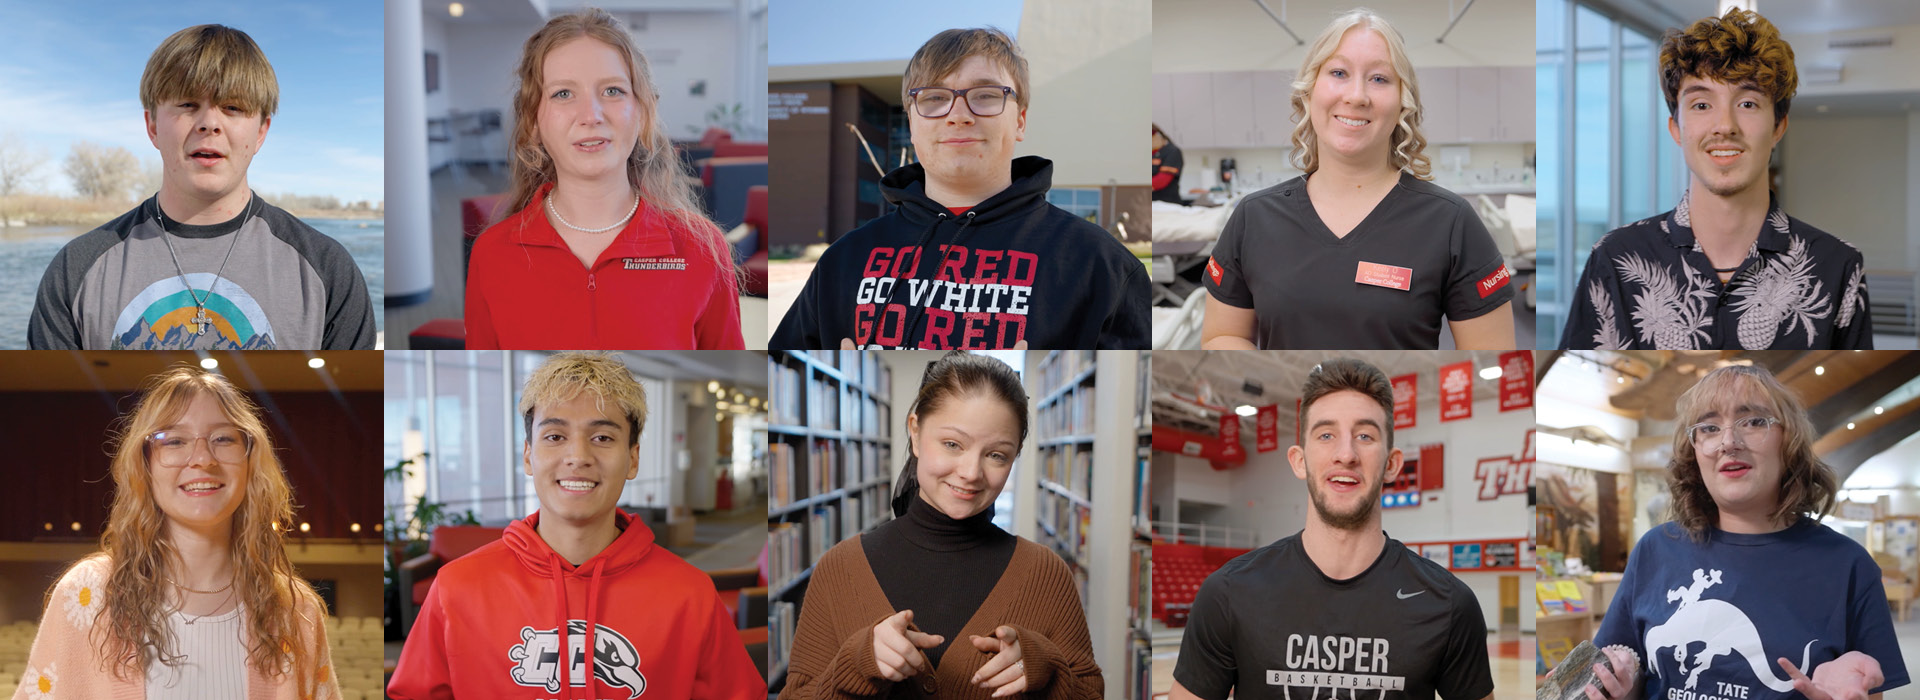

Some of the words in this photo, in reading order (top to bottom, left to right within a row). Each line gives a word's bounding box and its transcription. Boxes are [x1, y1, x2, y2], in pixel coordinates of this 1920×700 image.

[622, 258, 686, 271] THUNDERBIRDS
[863, 246, 923, 279] GO
[934, 244, 1039, 287] RED
[1483, 267, 1509, 290] Nursing
[856, 277, 896, 304] GO
[908, 278, 1032, 315] WHITE
[855, 303, 907, 346] GO
[918, 307, 1027, 350] RED
[1475, 455, 1536, 500] TH
[1285, 633, 1390, 674] CASPER
[1274, 672, 1398, 689] BASKETBALL
[1716, 682, 1750, 699] TATE
